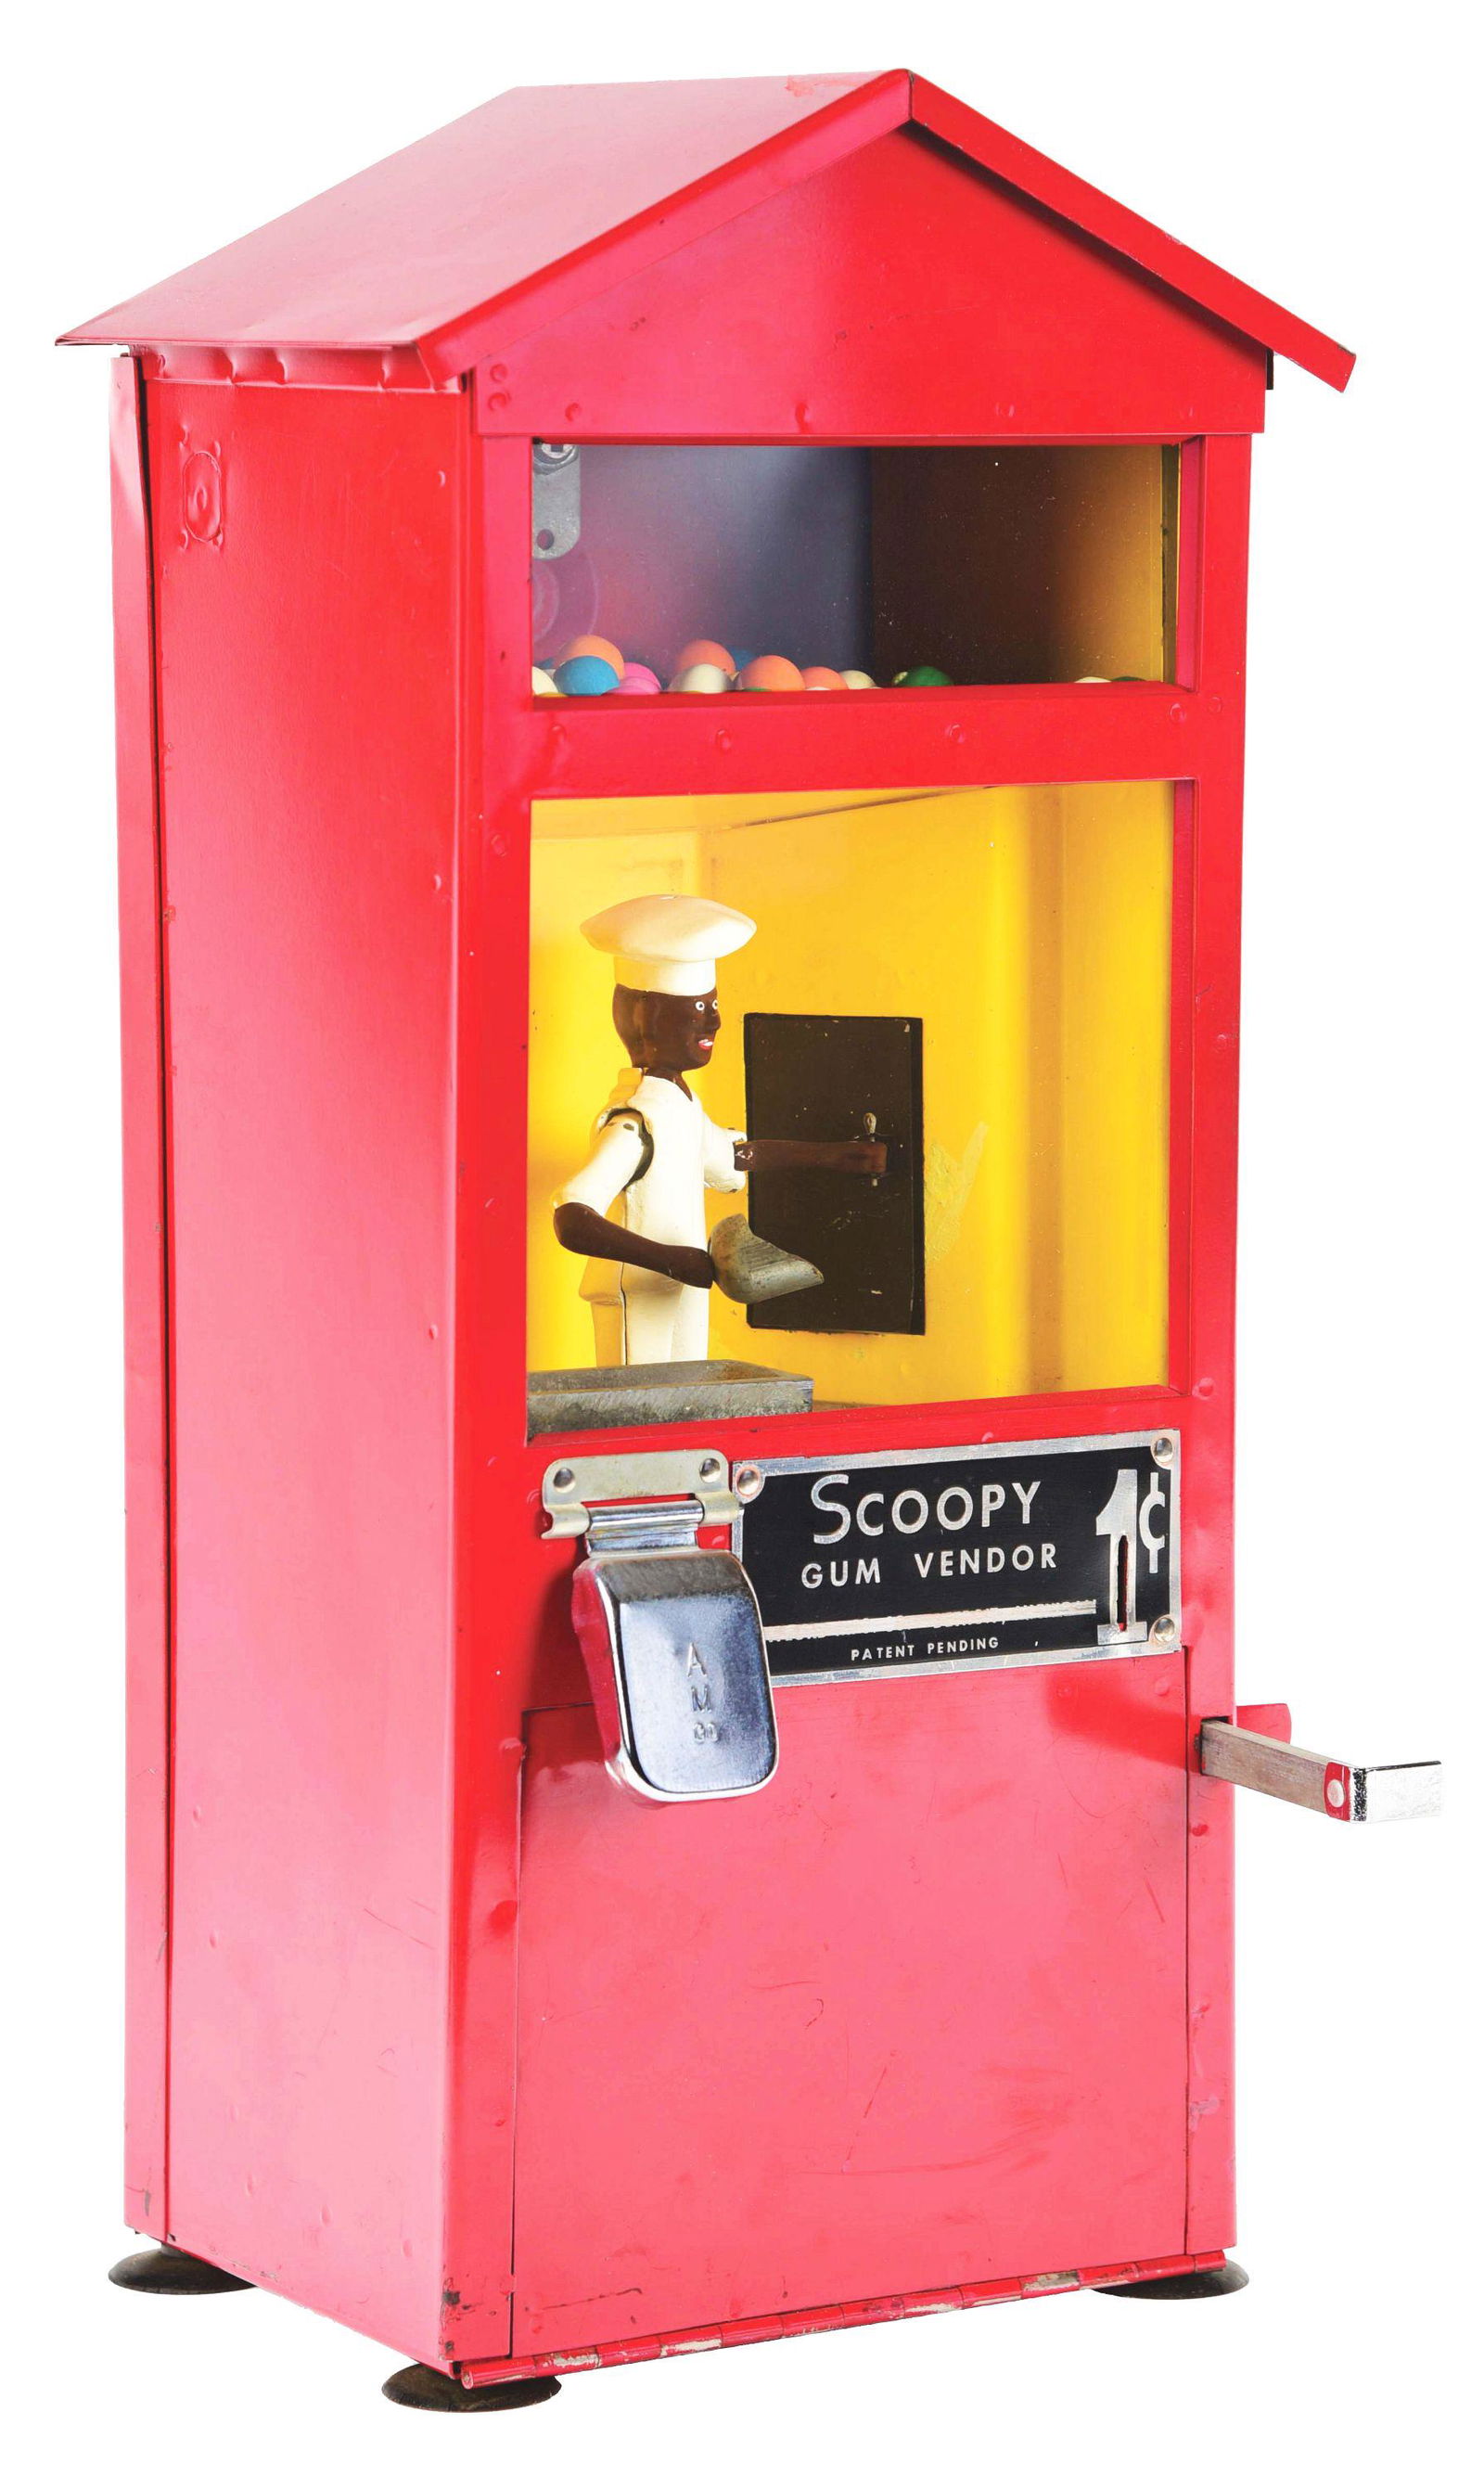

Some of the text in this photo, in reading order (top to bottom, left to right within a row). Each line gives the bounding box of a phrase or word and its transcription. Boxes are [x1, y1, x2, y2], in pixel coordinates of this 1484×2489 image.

[801, 1543, 1057, 1590] GUM VENDOR
[687, 1641, 708, 1678] A
[851, 1636, 1000, 1661] PATENT PENDING
[691, 1685, 711, 1713] M
